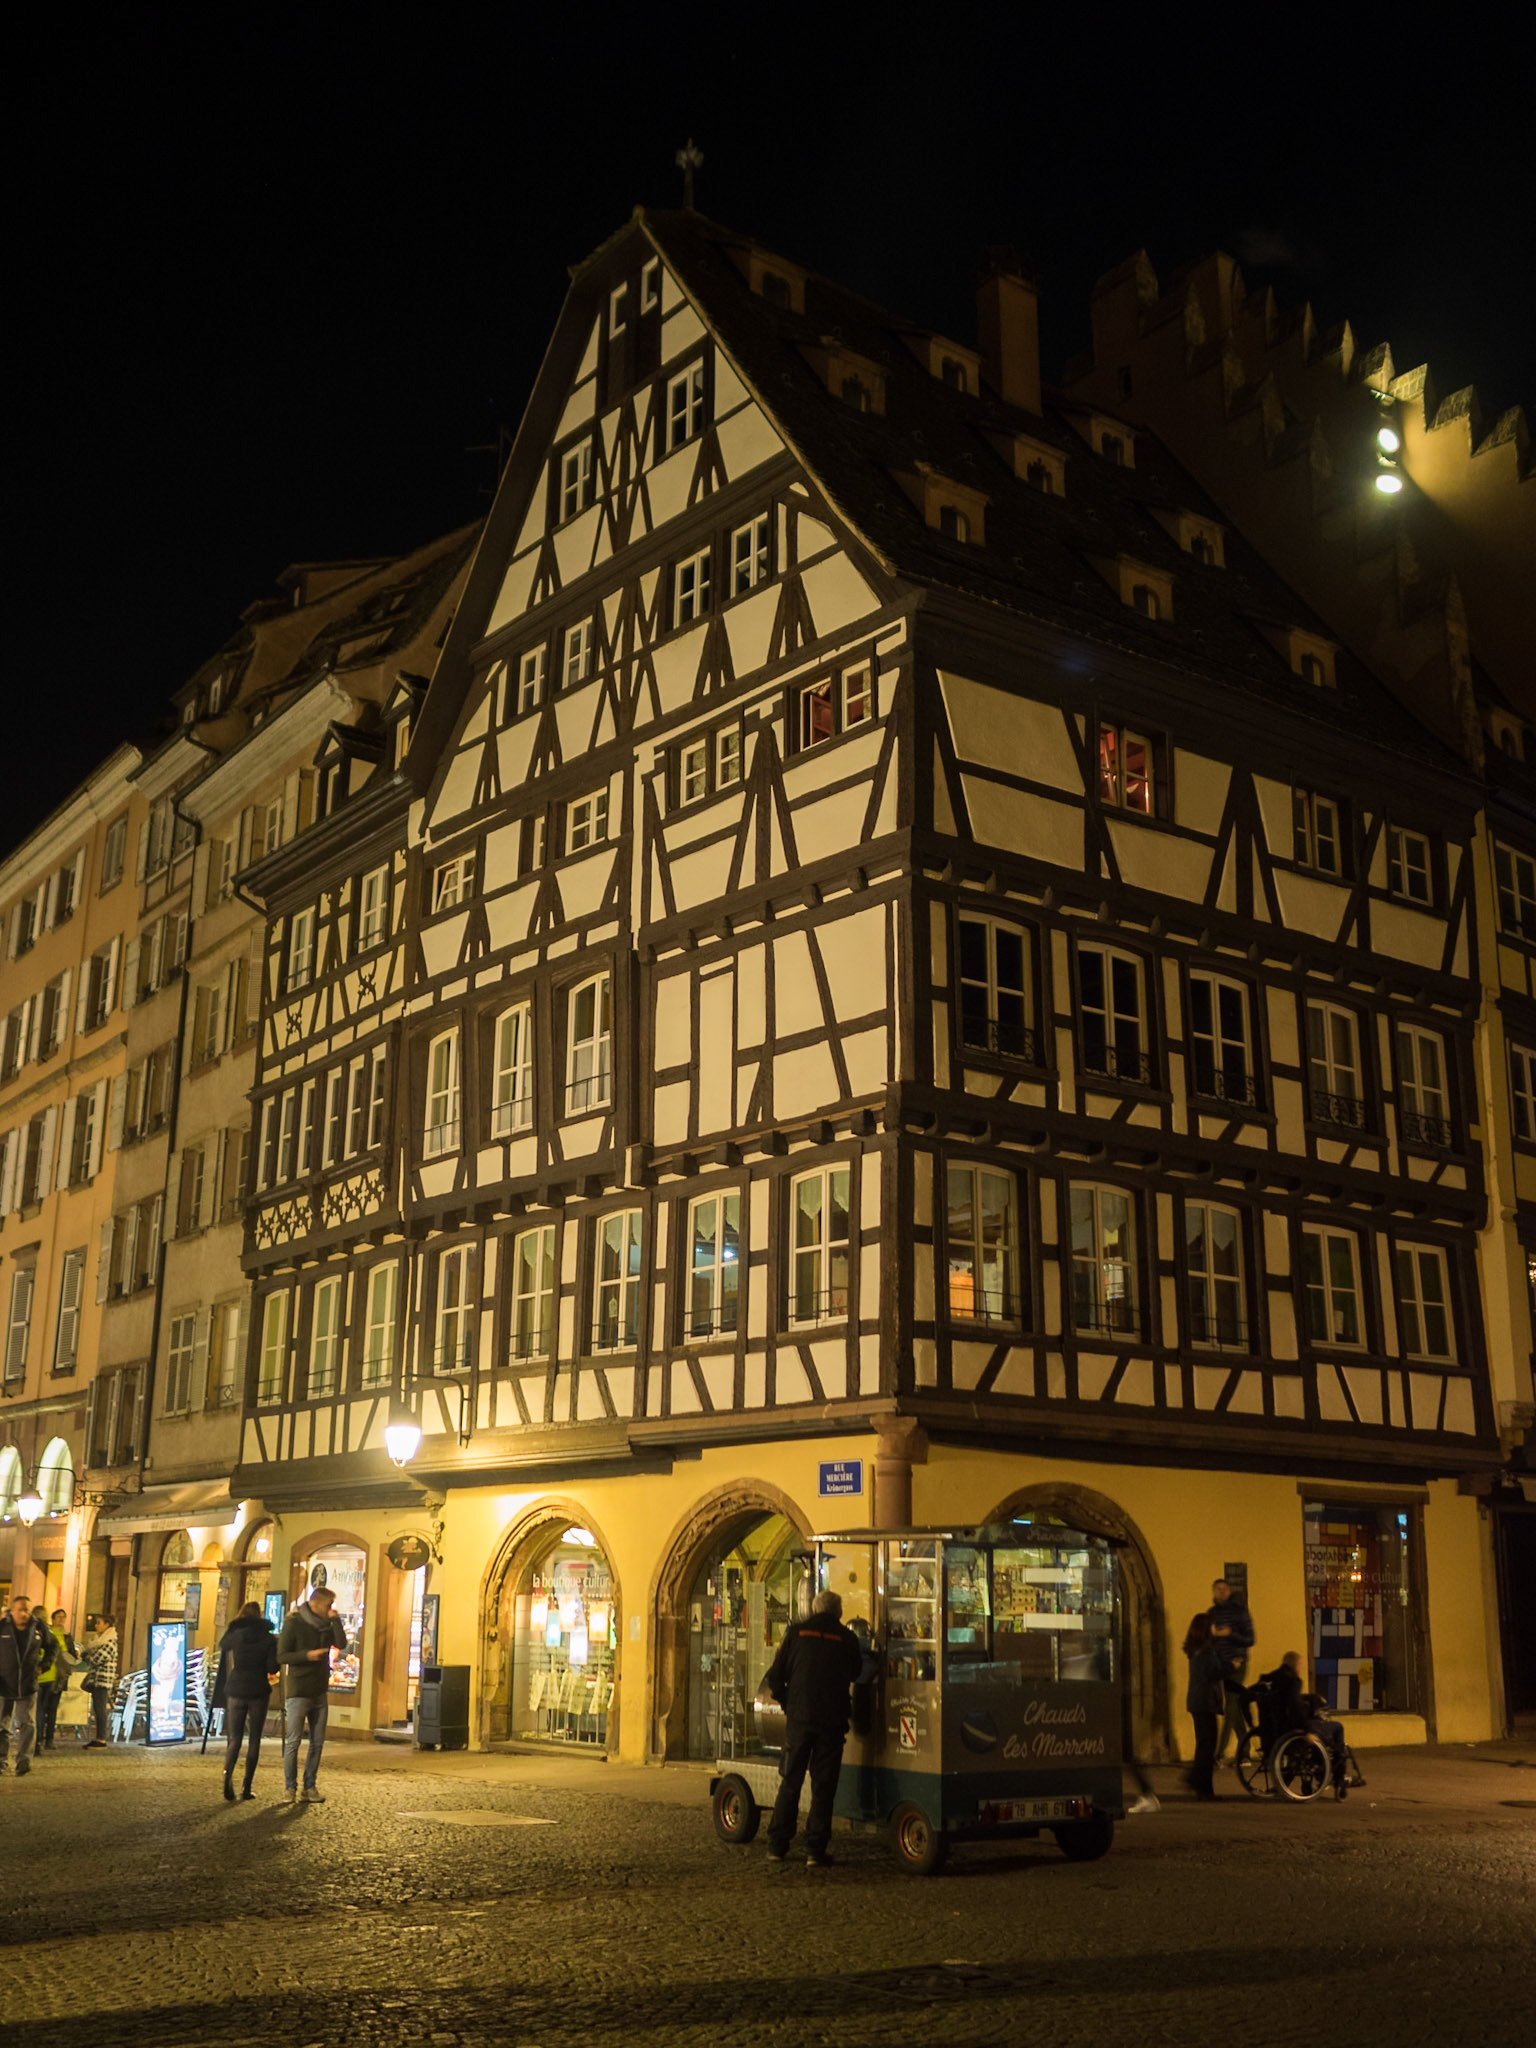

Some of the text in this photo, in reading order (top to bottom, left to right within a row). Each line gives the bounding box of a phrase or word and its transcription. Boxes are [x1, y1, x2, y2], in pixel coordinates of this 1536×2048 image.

[834, 1463, 846, 1472] RUE
[533, 1573, 540, 1588] la
[542, 1572, 581, 1593] boutique
[1024, 1699, 1087, 1726] Chauds
[1002, 1730, 1105, 1760] les Marrons
[1053, 1801, 1065, 1816] 67
